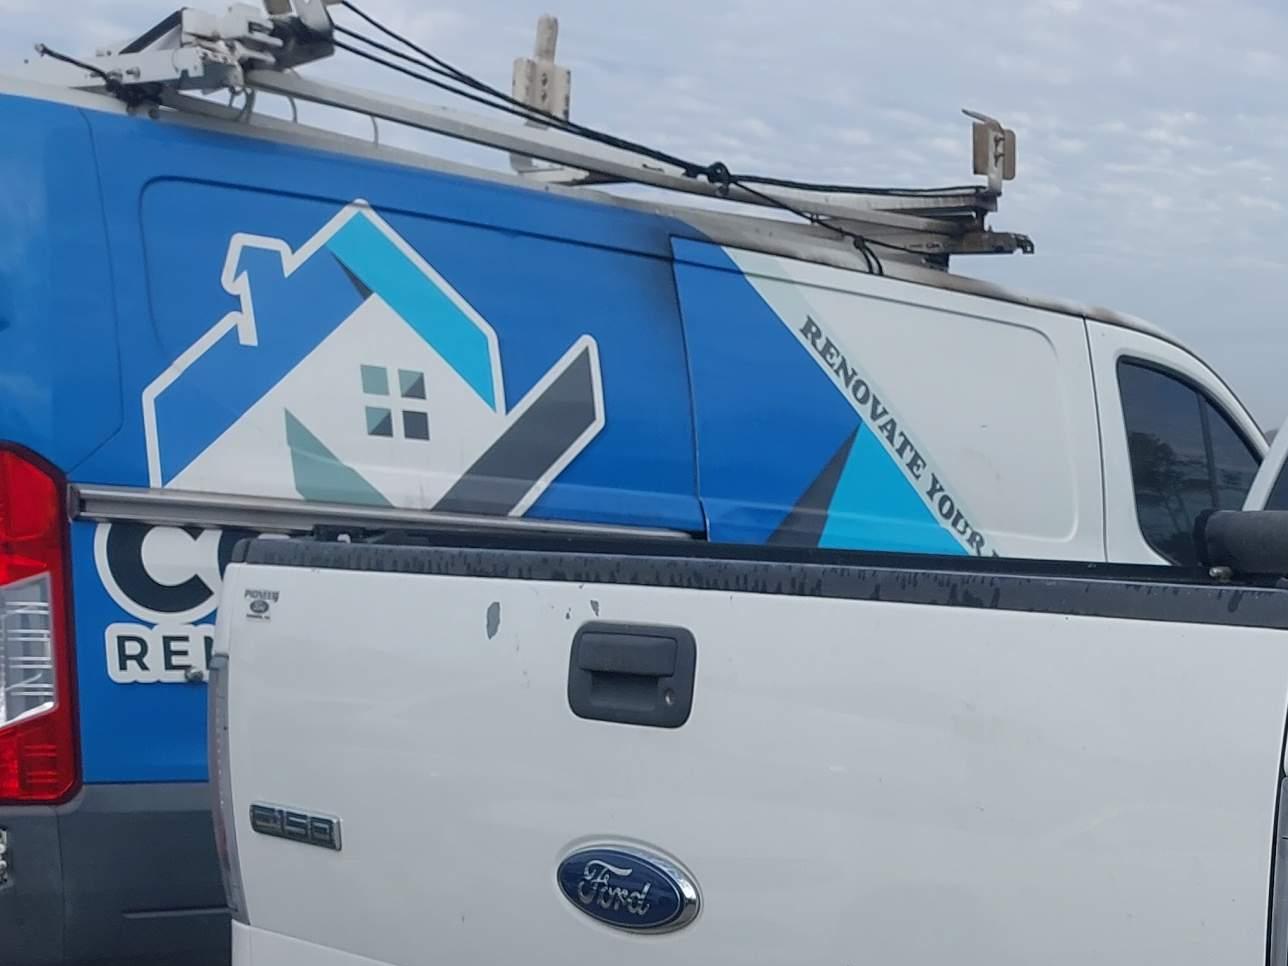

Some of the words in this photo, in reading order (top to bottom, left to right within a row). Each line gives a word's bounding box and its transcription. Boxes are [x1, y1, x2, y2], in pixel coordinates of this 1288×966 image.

[799, 316, 926, 478] RENOVATE
[926, 472, 986, 557] YOUR
[577, 859, 651, 915] Ford
